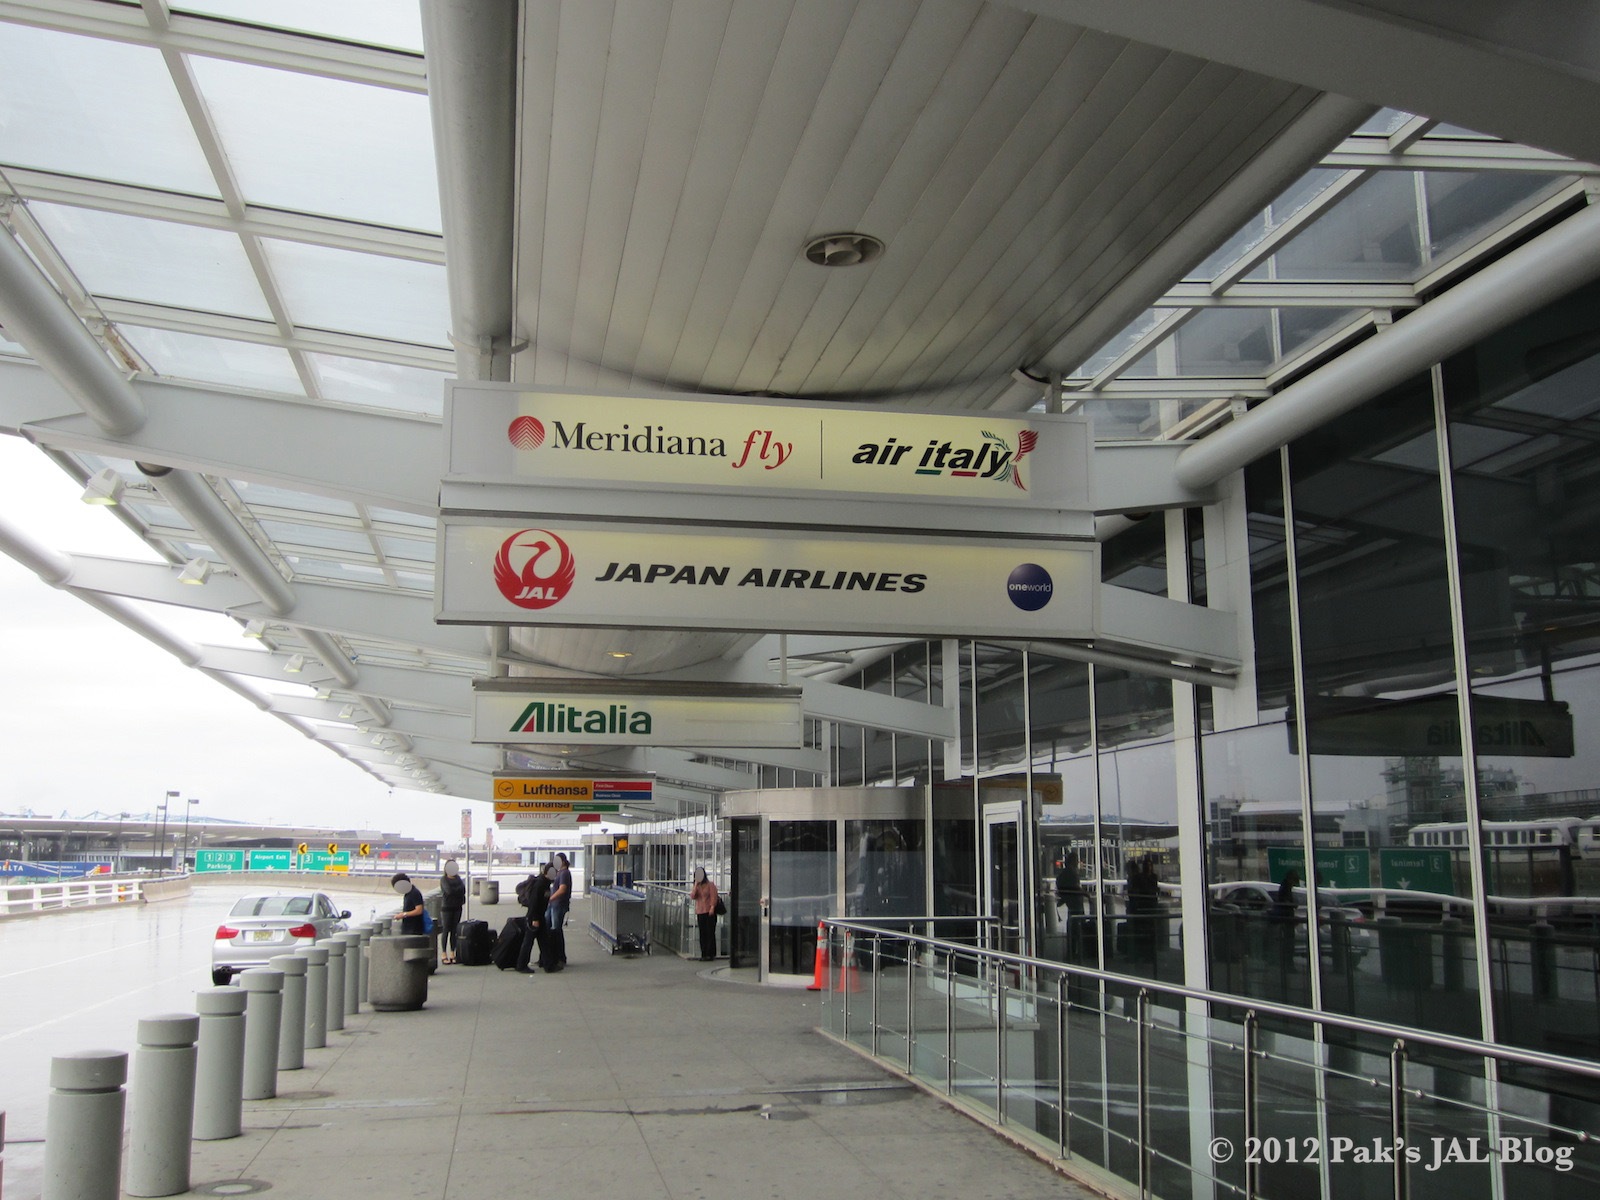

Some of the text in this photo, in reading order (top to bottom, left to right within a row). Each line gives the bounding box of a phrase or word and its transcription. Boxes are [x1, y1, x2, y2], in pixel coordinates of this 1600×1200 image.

[551, 420, 793, 470] Meridiana fly
[852, 437, 1013, 478] air italy
[514, 586, 558, 600] JAL
[595, 562, 928, 593] JAPAN AIRLINES
[1009, 583, 1051, 592] oneworld
[509, 702, 652, 734] Alitalia
[523, 783, 588, 796] Lufthansa
